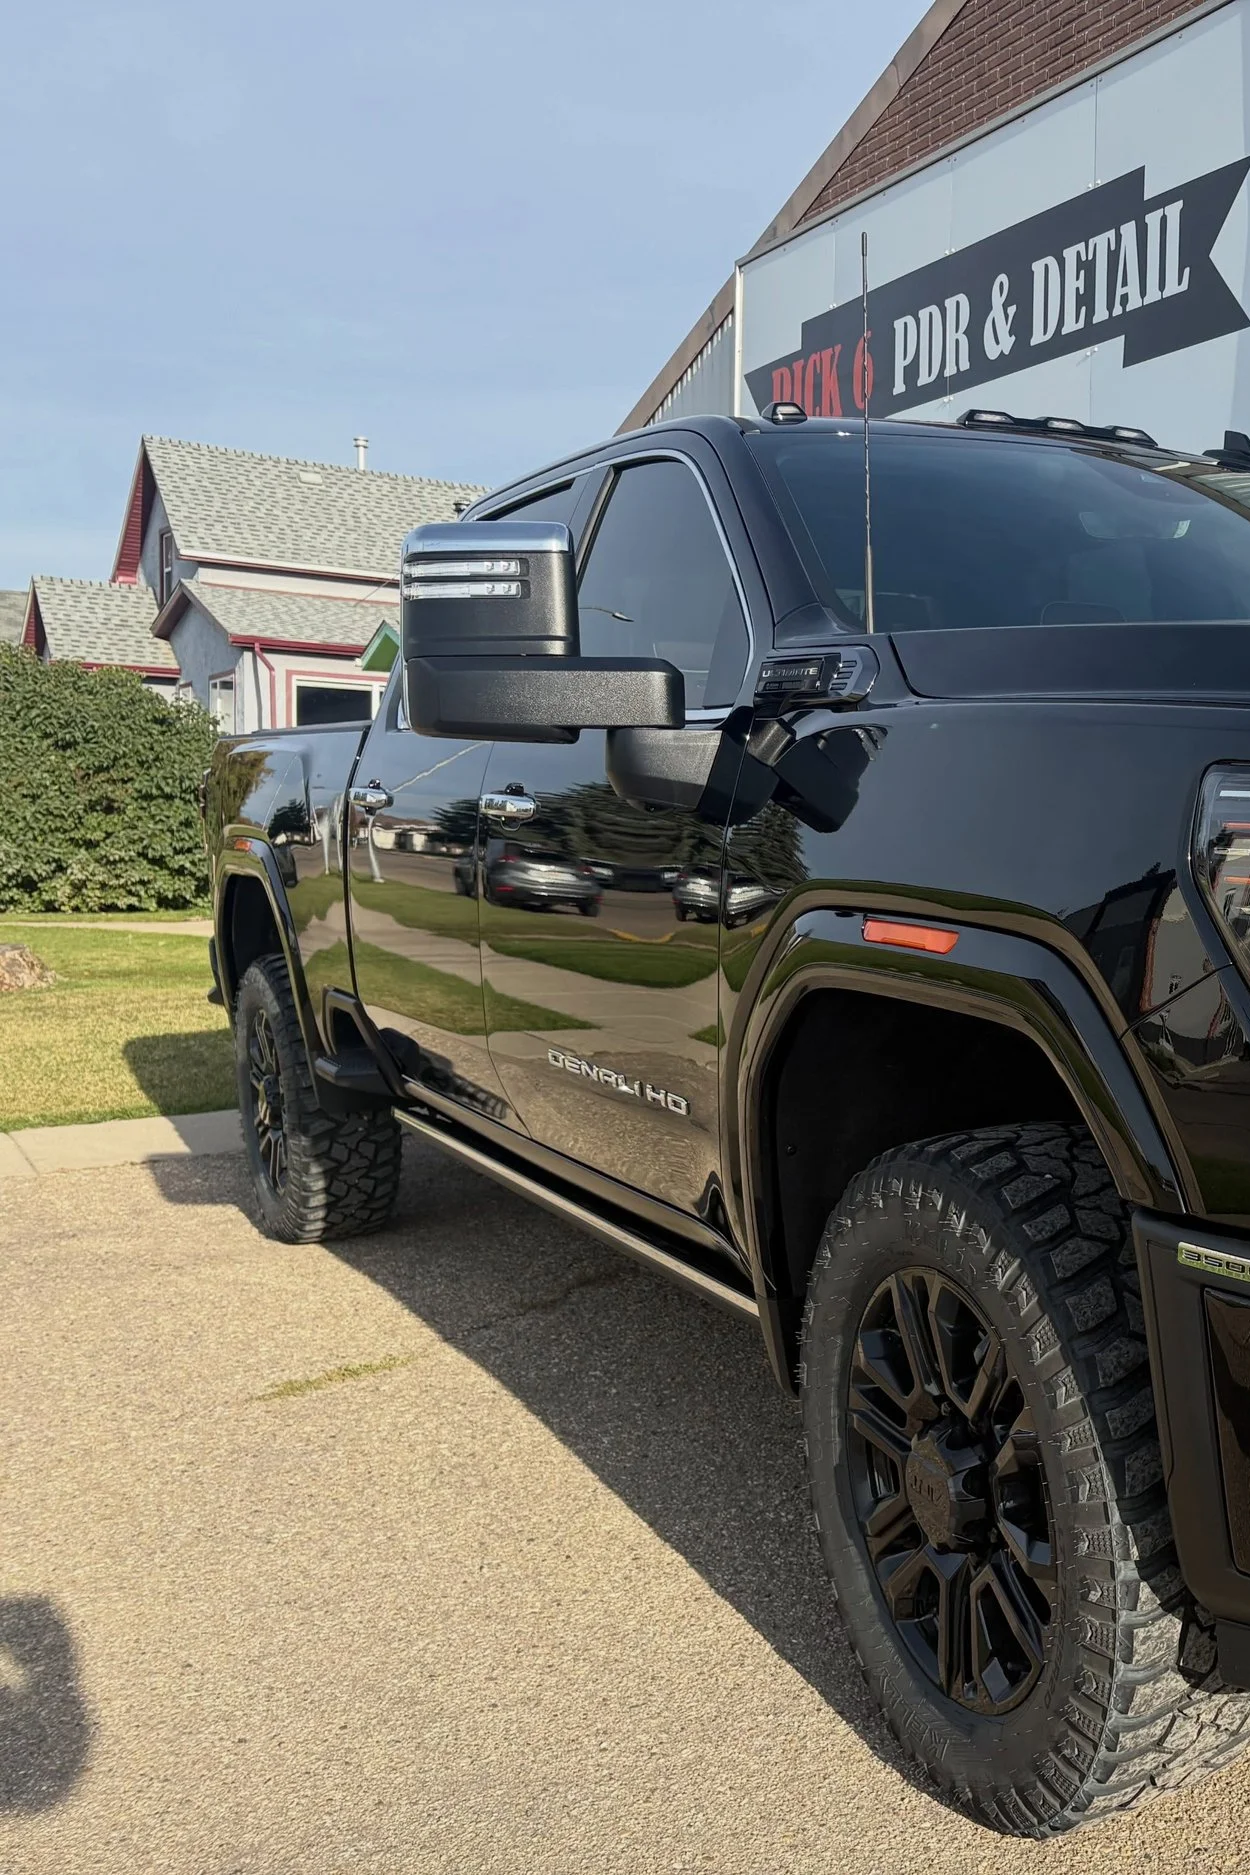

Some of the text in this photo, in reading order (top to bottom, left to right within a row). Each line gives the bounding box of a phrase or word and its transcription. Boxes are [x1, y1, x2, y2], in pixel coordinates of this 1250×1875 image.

[852, 330, 874, 410] 6
[893, 292, 970, 396] PDR
[983, 273, 1016, 360] &
[1030, 200, 1190, 346] DETAIL
[548, 1049, 691, 1116] DENALI HD
